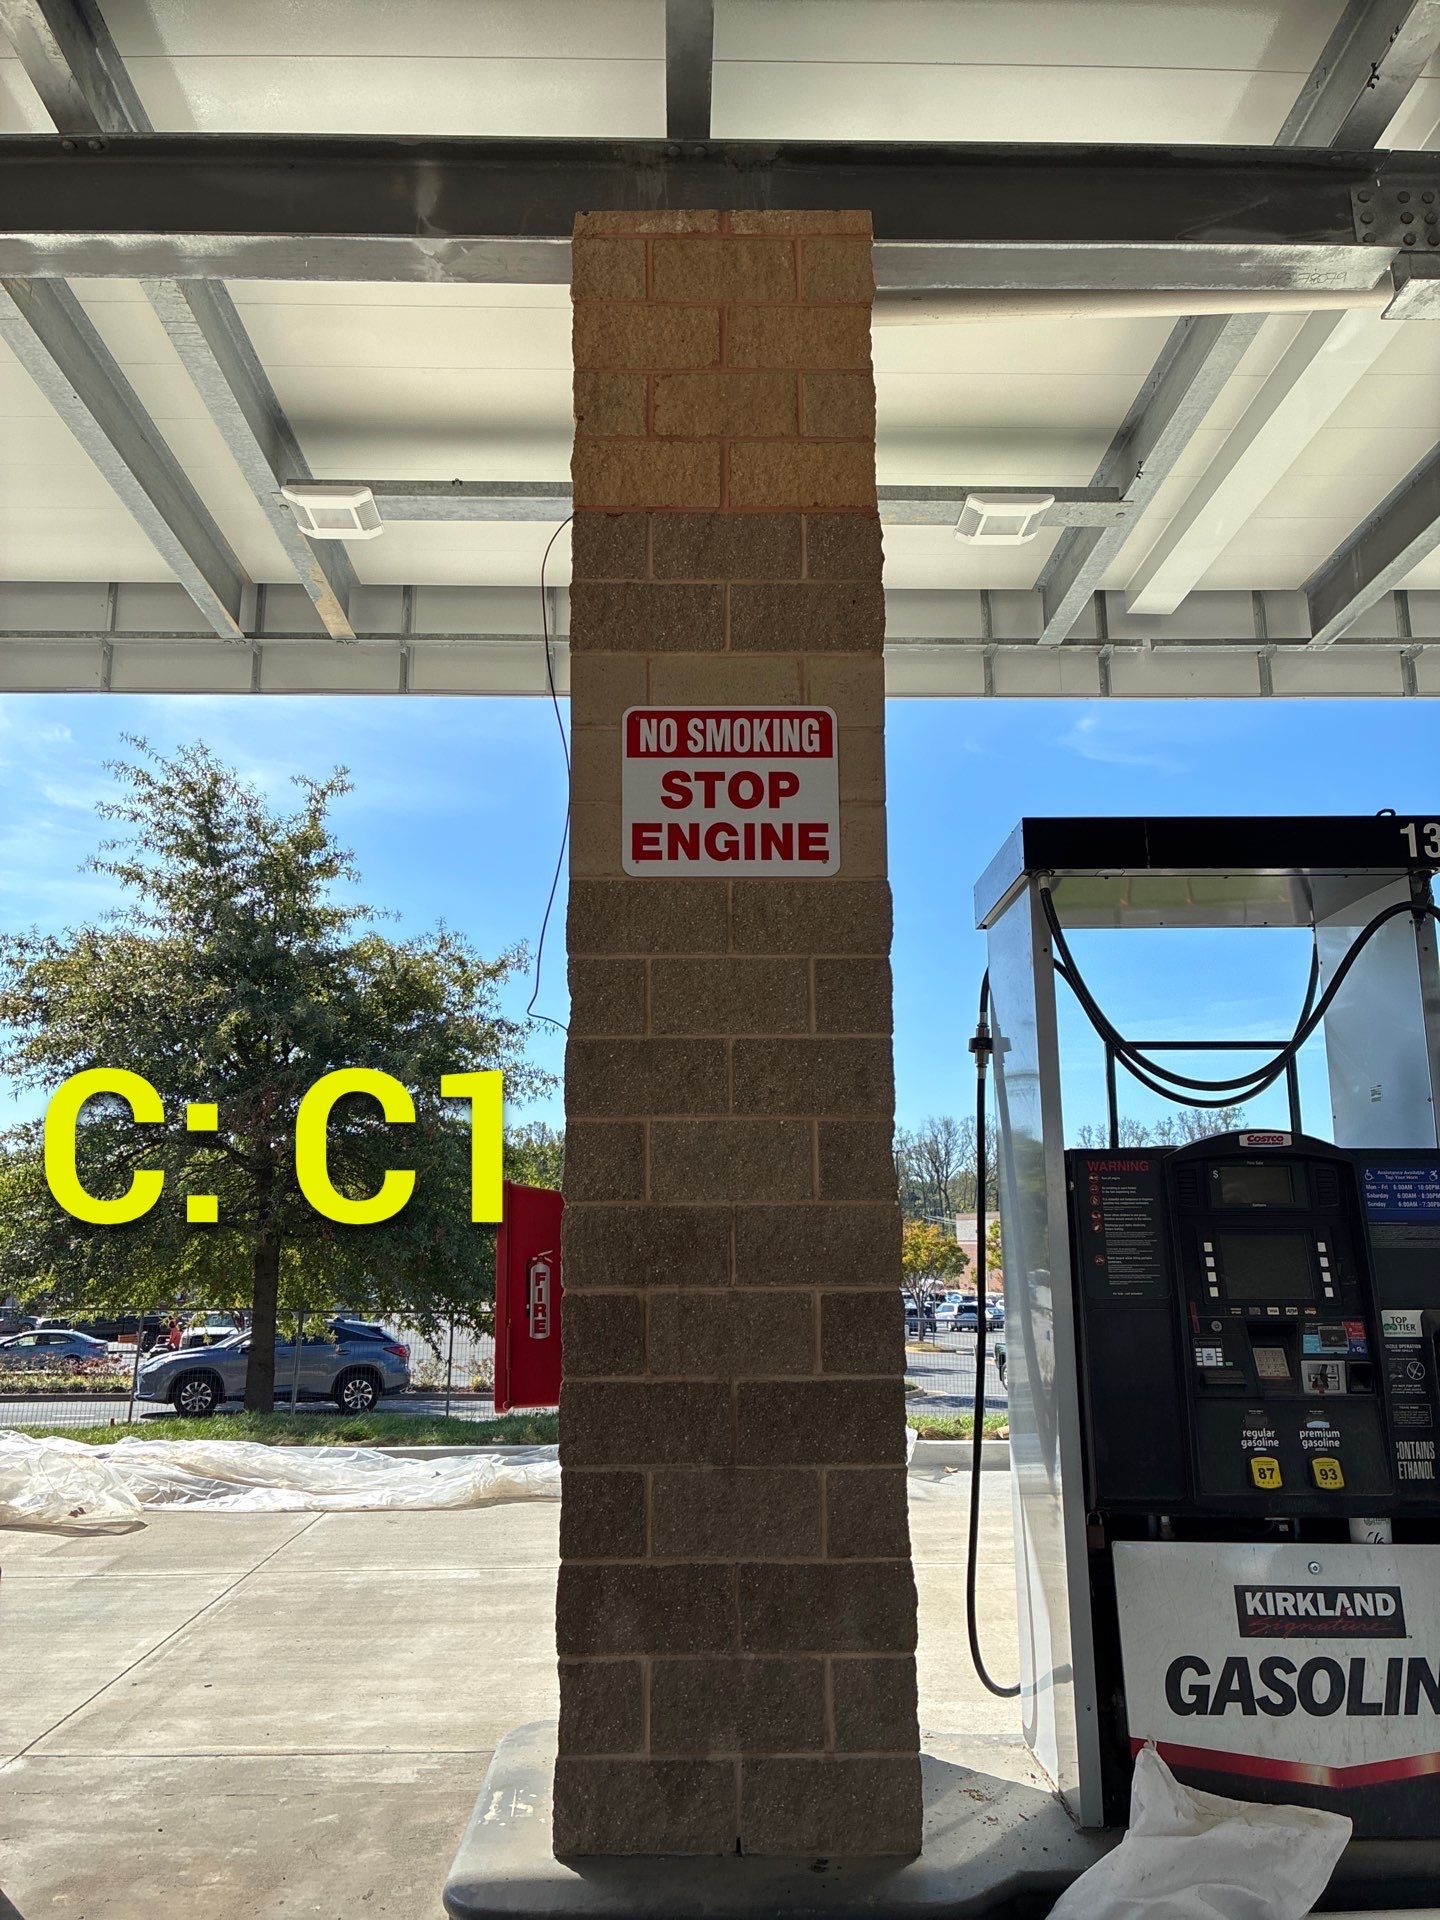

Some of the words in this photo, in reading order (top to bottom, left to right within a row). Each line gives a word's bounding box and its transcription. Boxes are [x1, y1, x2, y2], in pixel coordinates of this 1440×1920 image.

[639, 717, 678, 753] NO
[686, 717, 821, 753] SMOKING
[660, 769, 801, 810] STOP
[631, 821, 830, 862] ENGINE
[1400, 822, 1440, 858] 13
[1246, 1134, 1284, 1143] COSTCO
[1087, 1160, 1149, 1172] WARNING
[533, 1271, 547, 1334] FIRE
[1390, 1316, 1408, 1324] TOP
[1397, 1323, 1416, 1331] TIER
[1242, 1427, 1275, 1439] regular
[1299, 1428, 1341, 1439] premium
[1241, 1438, 1279, 1449] gasoline
[1302, 1439, 1340, 1449] gasoline
[1258, 1467, 1275, 1480] 87
[1320, 1468, 1338, 1481] 93
[1397, 1461, 1436, 1480] ETHANOL
[1244, 1591, 1397, 1617] KIRKLAND
[1247, 1616, 1398, 1639] Signature
[1164, 1655, 1440, 1717] GASOLIN
